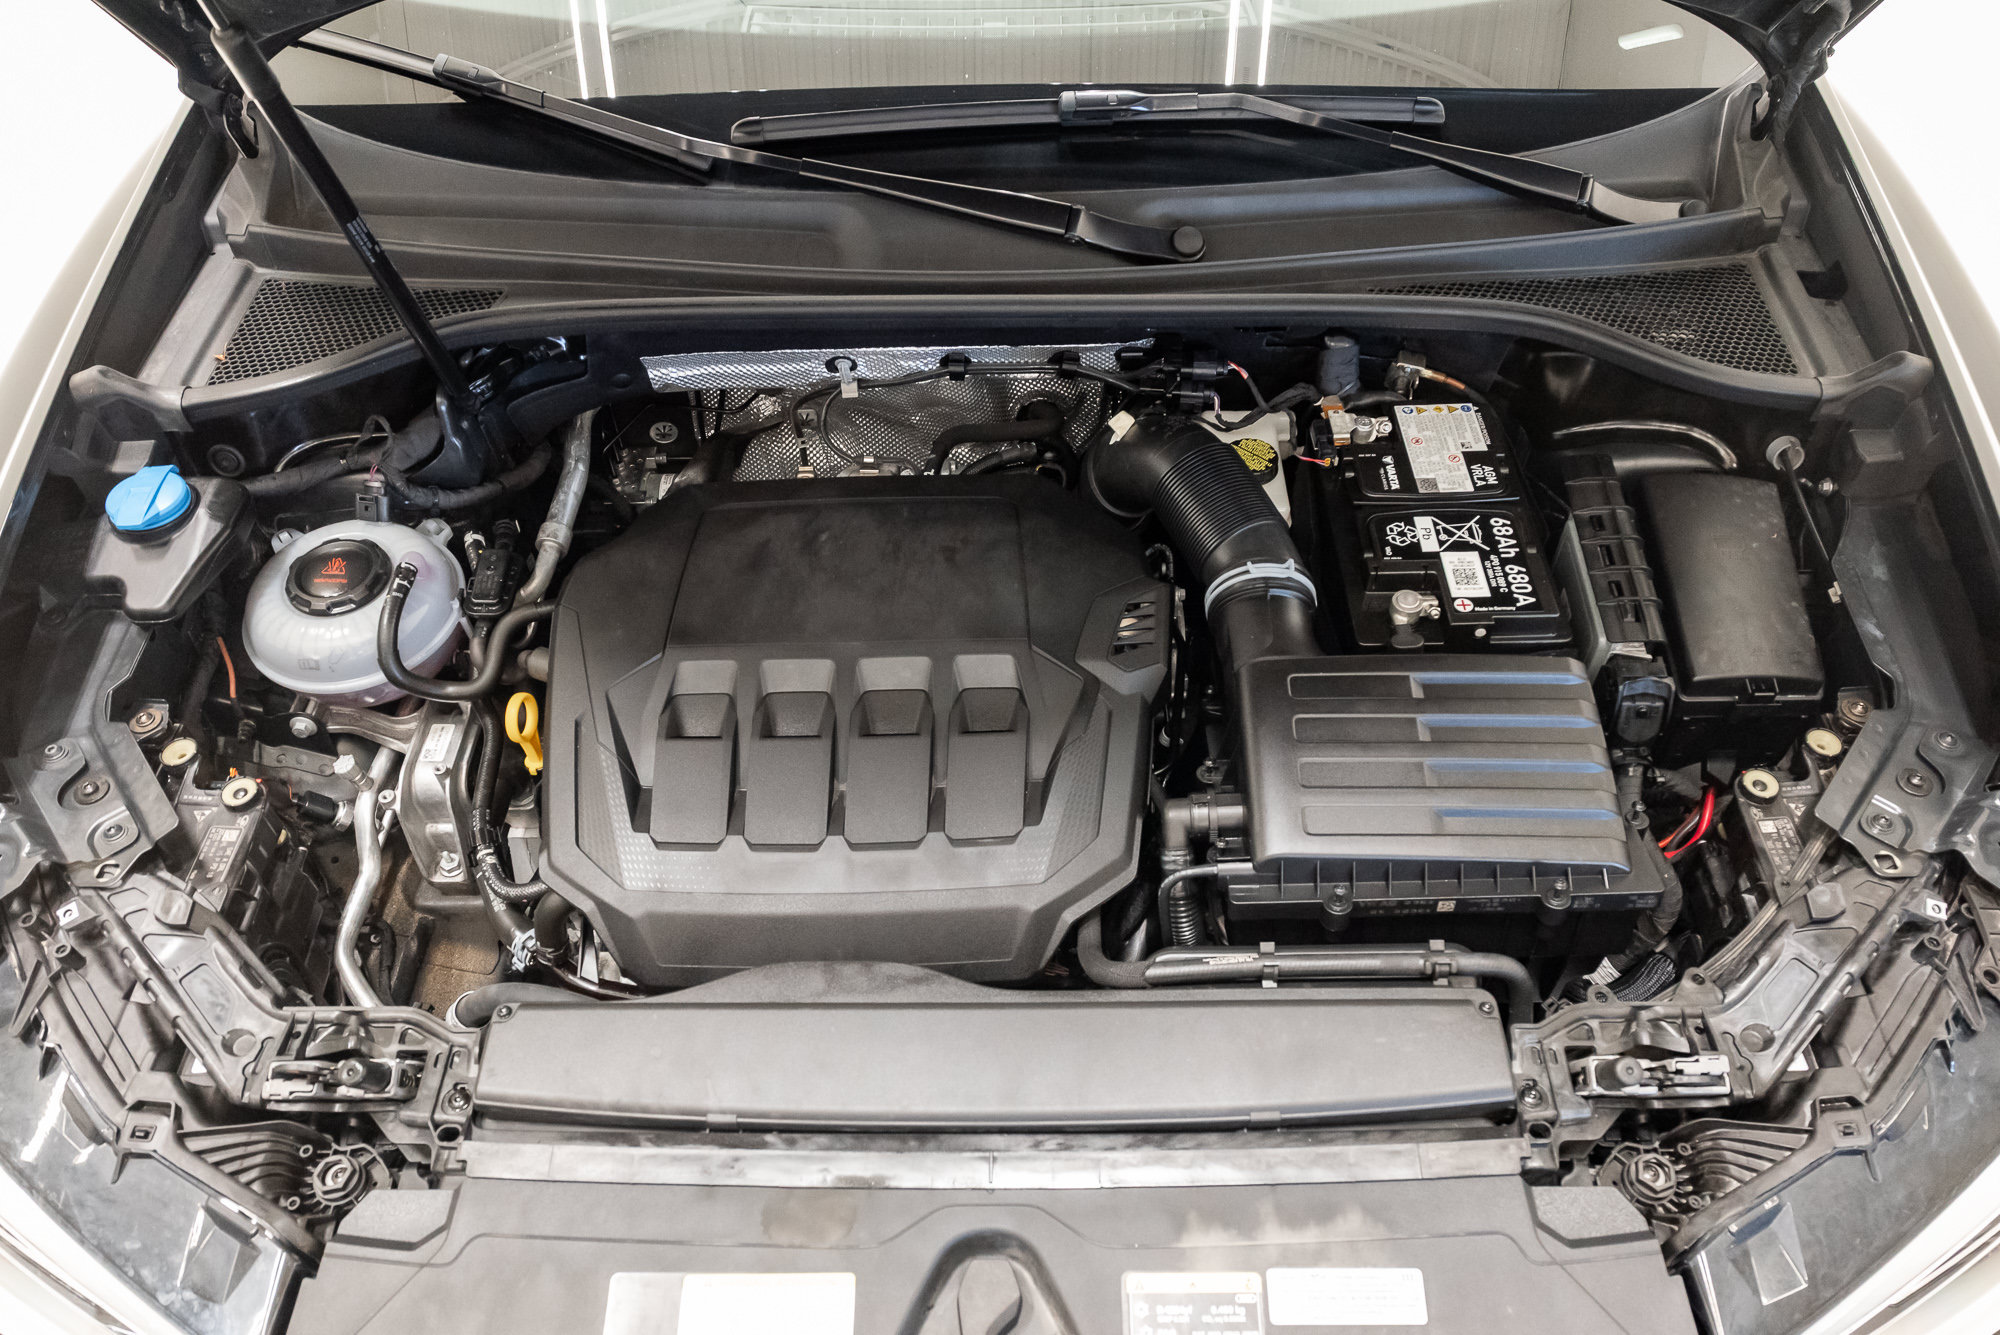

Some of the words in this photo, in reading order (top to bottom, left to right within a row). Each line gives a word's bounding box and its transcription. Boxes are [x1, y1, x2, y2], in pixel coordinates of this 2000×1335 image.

[1386, 464, 1400, 490] VARTA
[1470, 463, 1487, 487] VRLA
[1482, 465, 1498, 484] AGM
[1420, 527, 1433, 540] Pb
[1489, 517, 1520, 558] 68Ah
[1504, 564, 1537, 607] 680A
